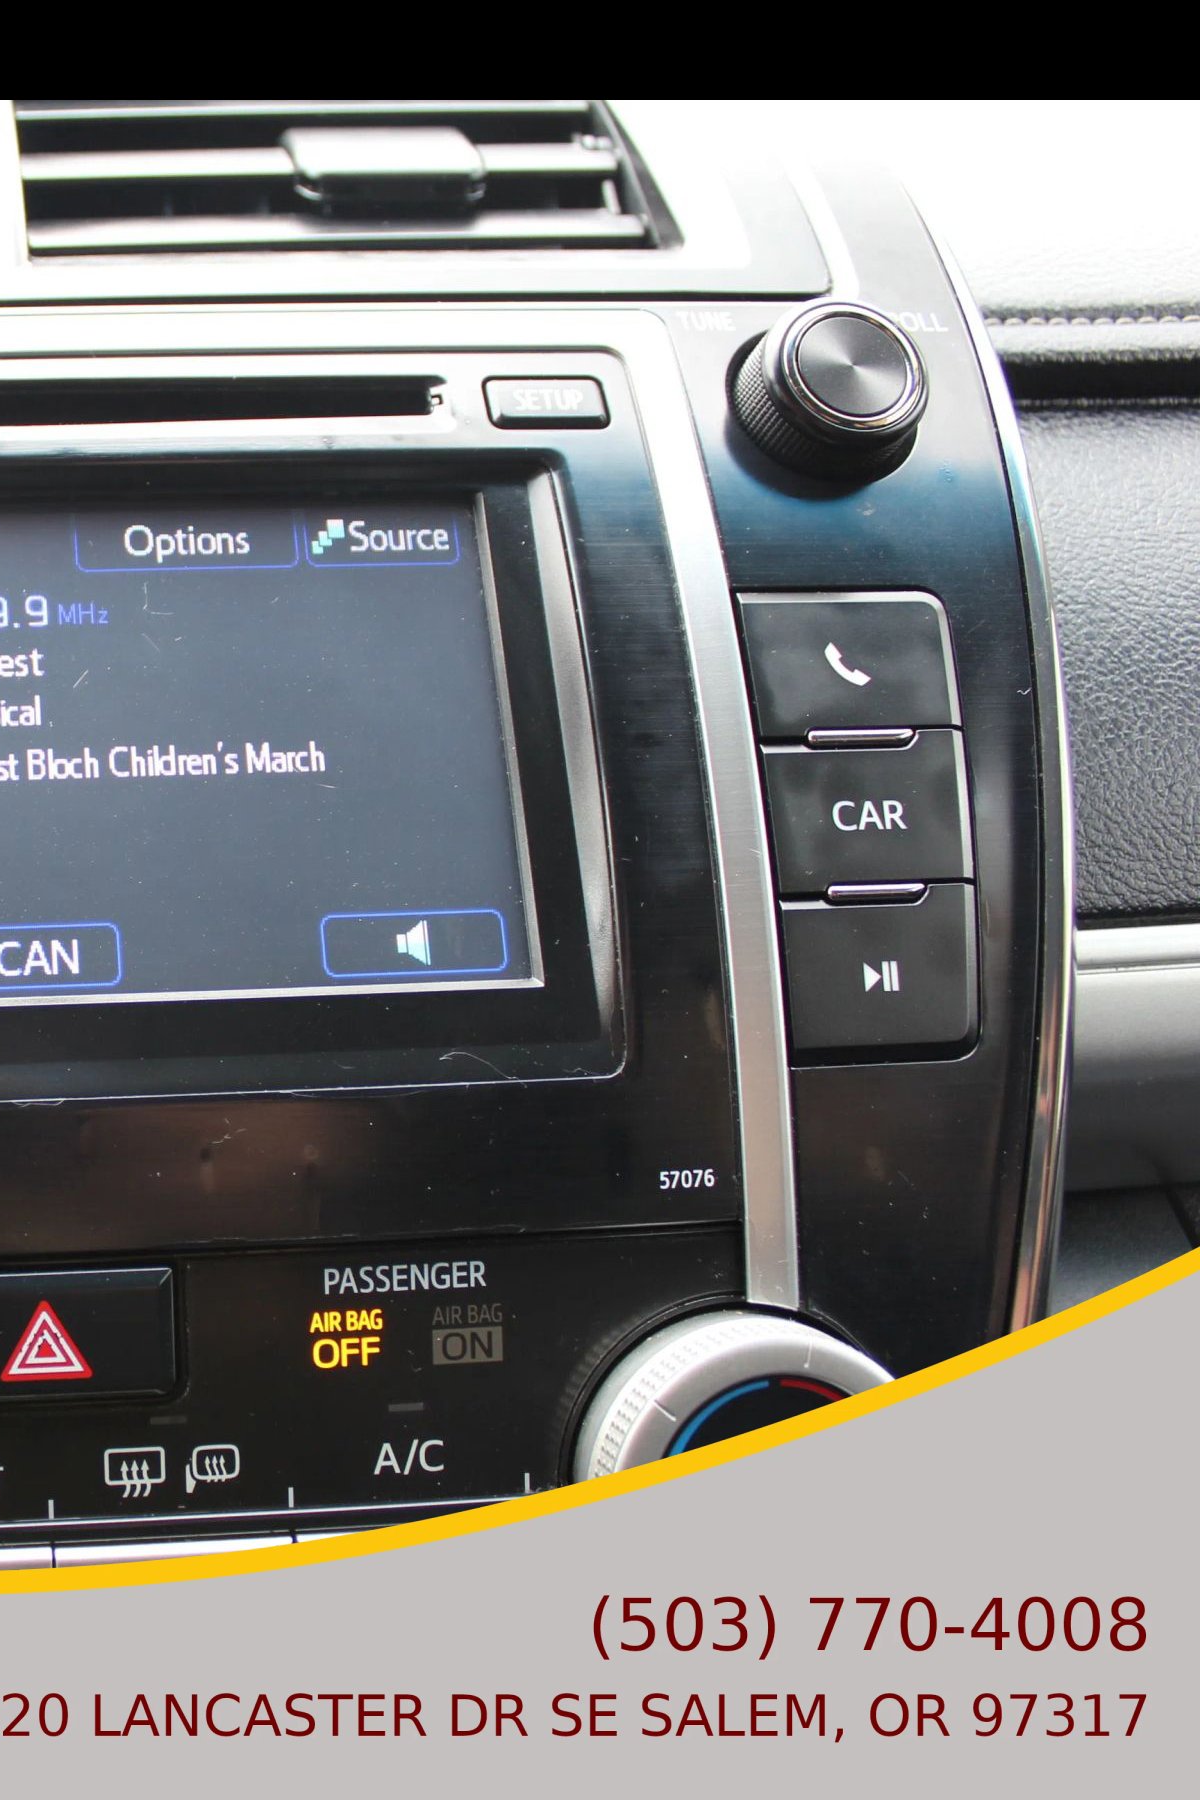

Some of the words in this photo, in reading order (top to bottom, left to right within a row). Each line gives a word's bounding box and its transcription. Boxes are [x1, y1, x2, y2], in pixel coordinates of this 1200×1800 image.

[676, 311, 736, 332] TUNE
[512, 388, 584, 411] SETUP
[123, 524, 251, 563] Options
[348, 521, 450, 554] Source
[57, 603, 108, 626] MHz
[27, 747, 100, 782] Bloch
[108, 741, 240, 778] Children's
[246, 741, 326, 775] March
[832, 799, 908, 832] CAR
[659, 1168, 716, 1190] 57076
[323, 1260, 487, 1296] PASSENGER
[309, 1312, 341, 1333] AIR
[346, 1308, 383, 1331] BAG
[432, 1306, 462, 1326] AIR
[467, 1303, 503, 1324] BAG
[312, 1336, 380, 1369] OFF
[441, 1331, 494, 1361] ON
[374, 1439, 445, 1475] A/C
